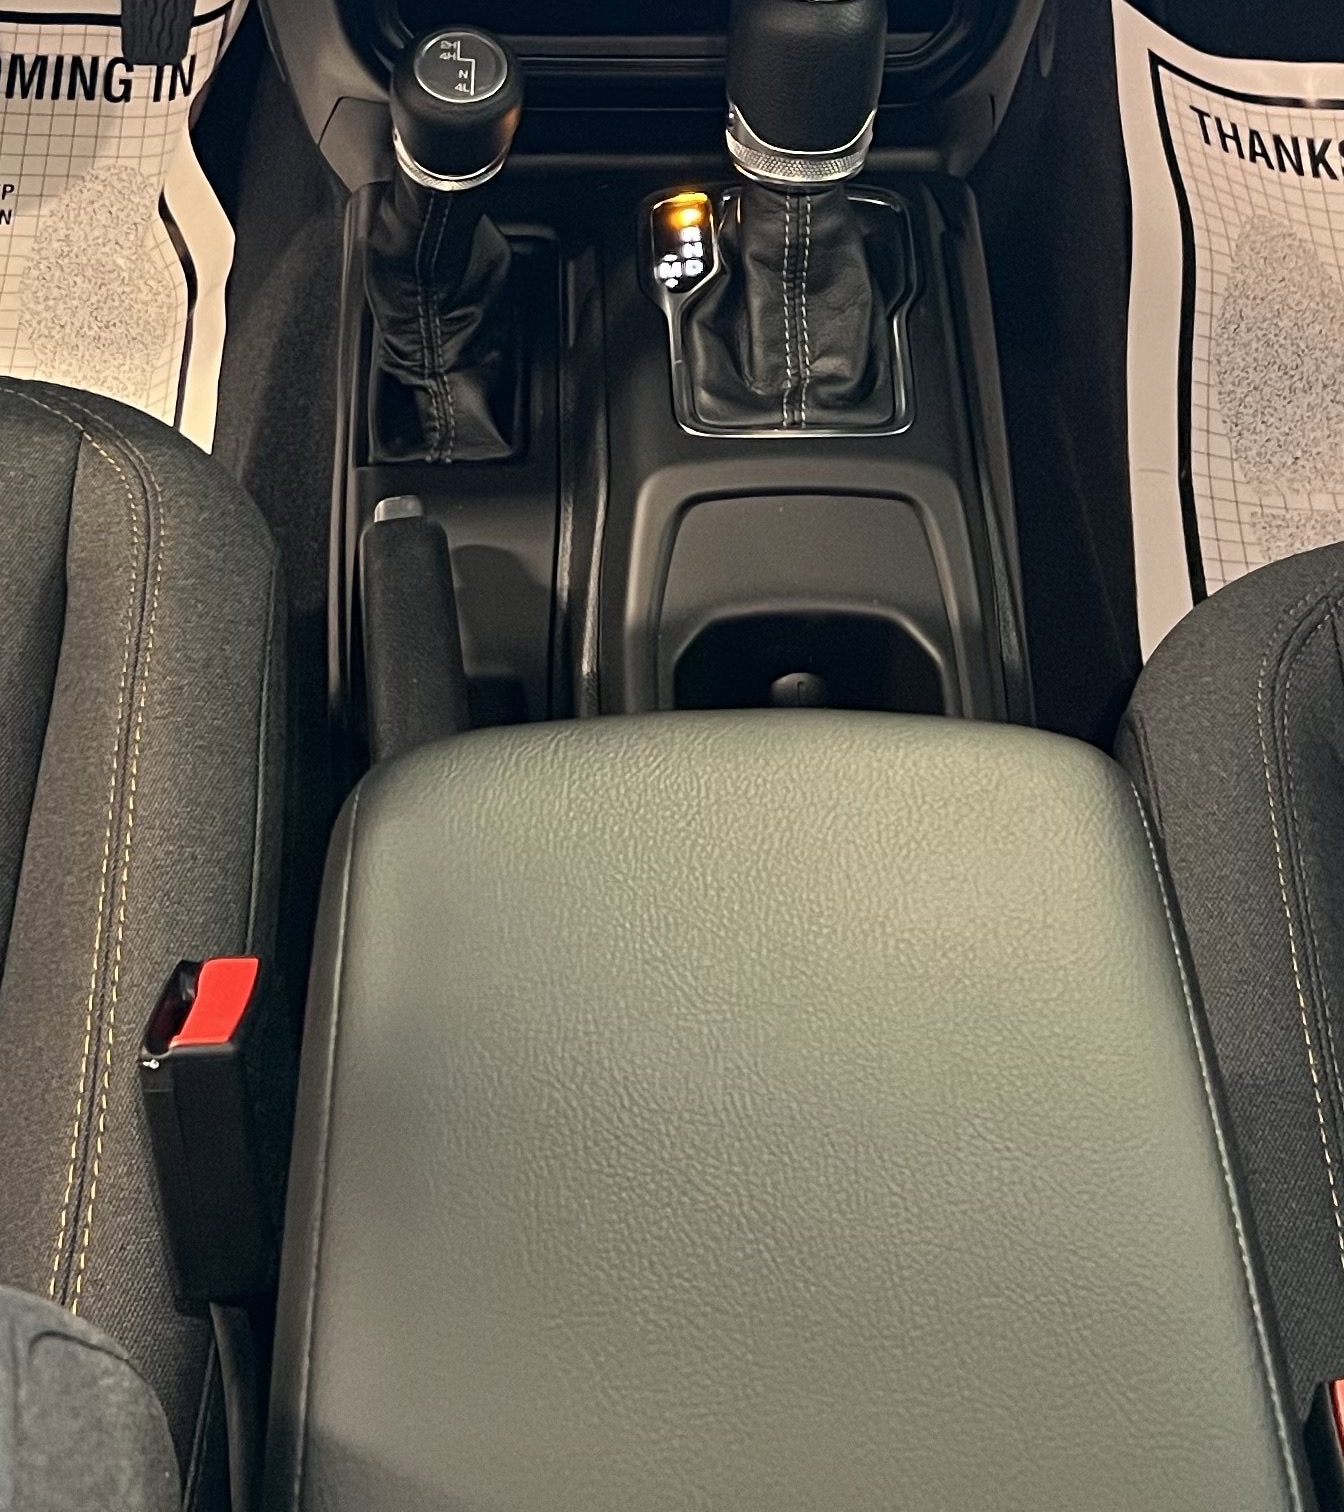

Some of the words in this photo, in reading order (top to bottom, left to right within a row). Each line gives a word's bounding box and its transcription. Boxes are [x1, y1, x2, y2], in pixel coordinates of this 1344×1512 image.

[439, 52, 456, 60] 4H
[153, 55, 196, 102] IN
[458, 69, 469, 79] N
[454, 83, 469, 92] 4L
